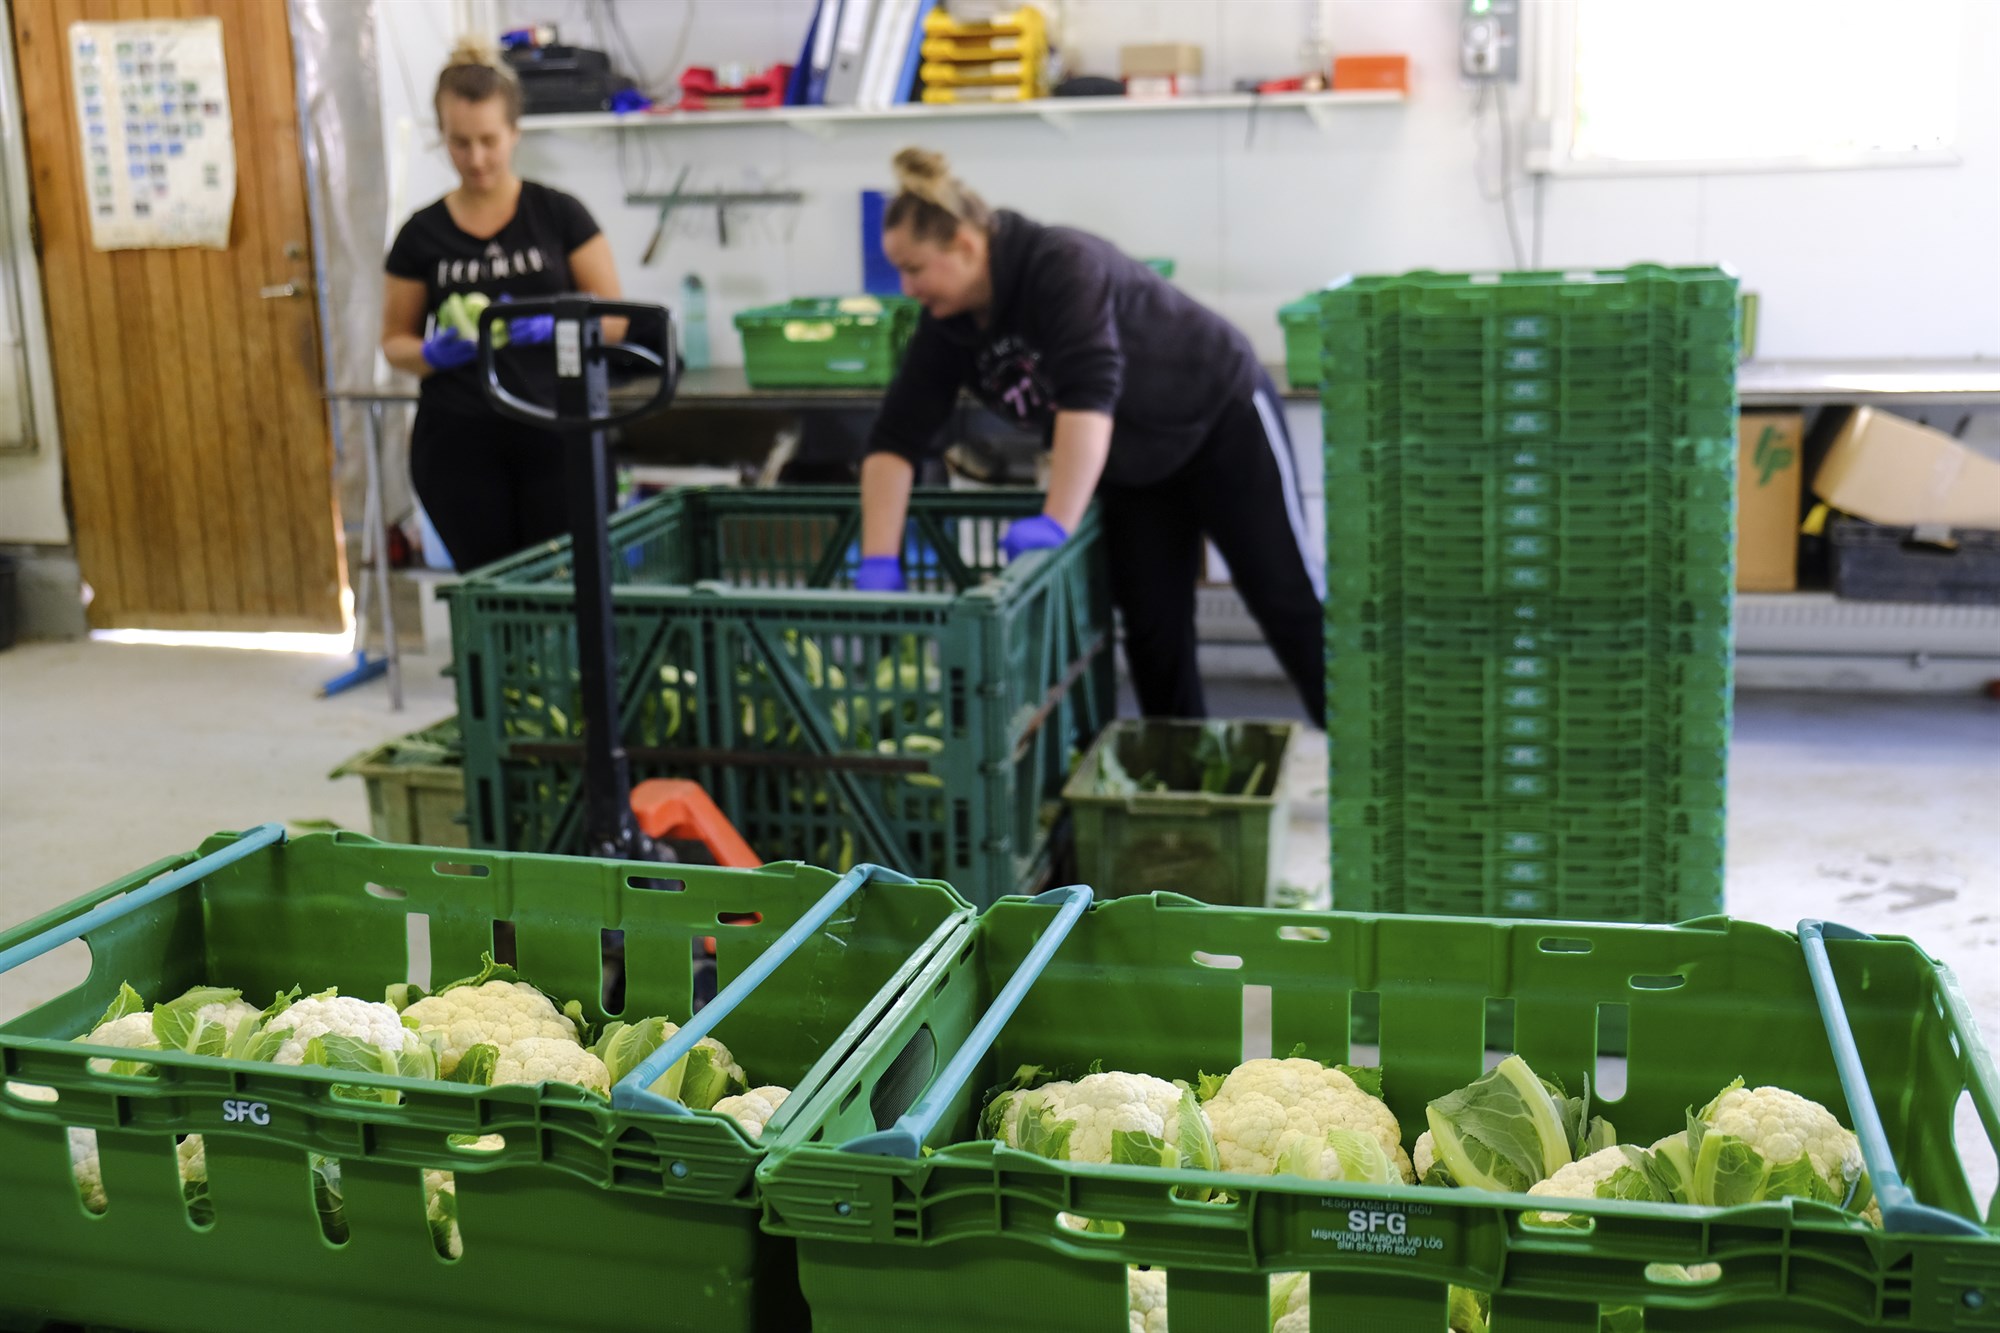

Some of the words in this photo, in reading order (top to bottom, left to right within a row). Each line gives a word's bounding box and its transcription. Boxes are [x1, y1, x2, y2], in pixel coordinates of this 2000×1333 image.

[222, 1099, 270, 1125] SFG
[1408, 1204, 1432, 1215] EIGU
[1348, 1210, 1406, 1235] SFG
[1311, 1229, 1366, 1243] MISNOTKUN
[1375, 1244, 1393, 1254] 570
